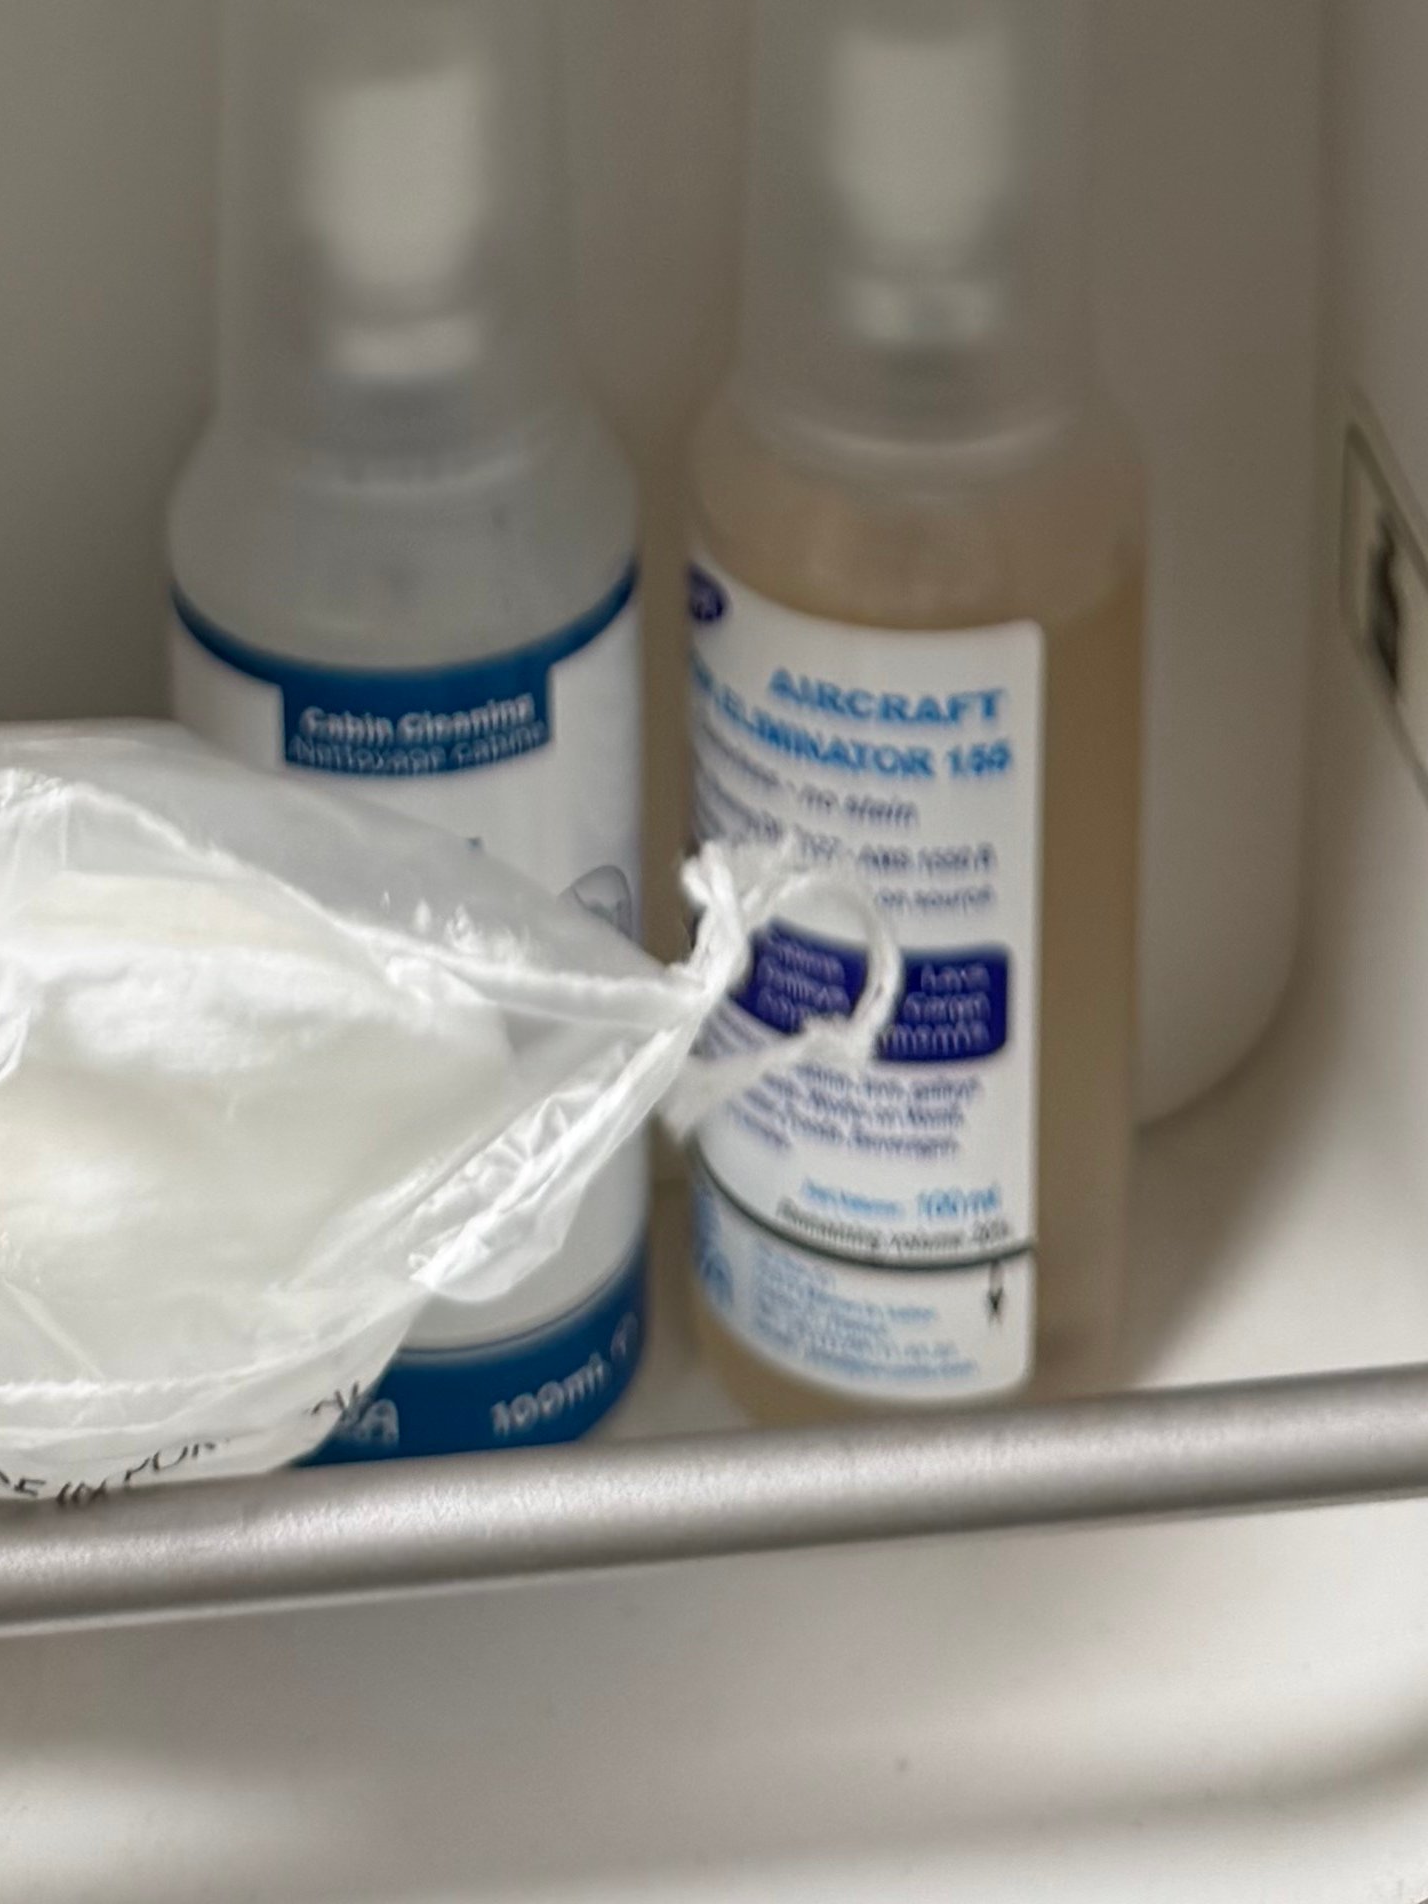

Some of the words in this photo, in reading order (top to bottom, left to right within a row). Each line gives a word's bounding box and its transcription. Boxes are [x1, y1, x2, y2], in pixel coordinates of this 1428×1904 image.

[299, 705, 394, 747] Cabin
[396, 691, 535, 746] Cleaning
[768, 668, 1006, 724] AIRCRAFT
